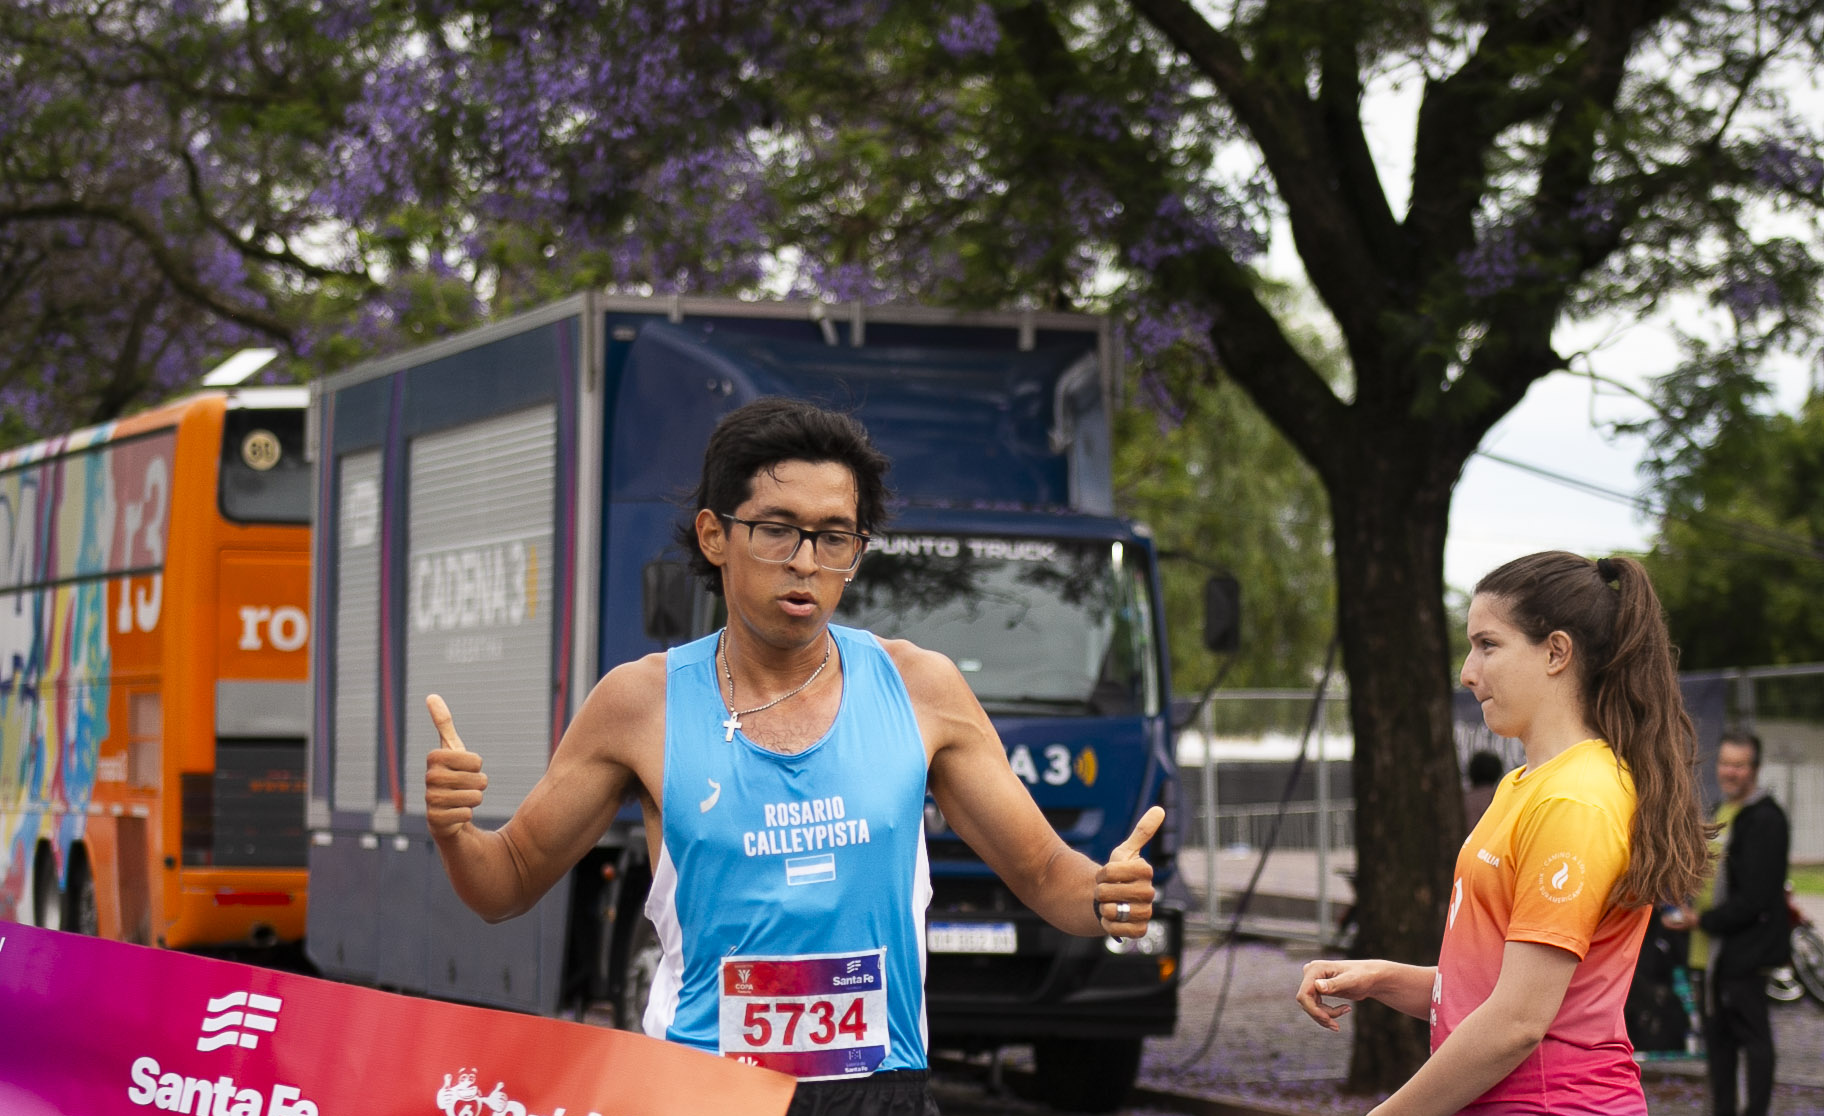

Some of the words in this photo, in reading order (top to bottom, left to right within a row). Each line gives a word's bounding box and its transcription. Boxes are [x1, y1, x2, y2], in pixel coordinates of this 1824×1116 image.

[965, 539, 1056, 561] TRUCK
[238, 605, 309, 652] ro
[1043, 744, 1072, 785] 3
[764, 796, 845, 828] ROSARIO
[743, 818, 870, 857] CALLEYPISTA
[832, 974, 863, 986] Santa
[863, 973, 875, 984] Fe
[743, 997, 868, 1048] 5734
